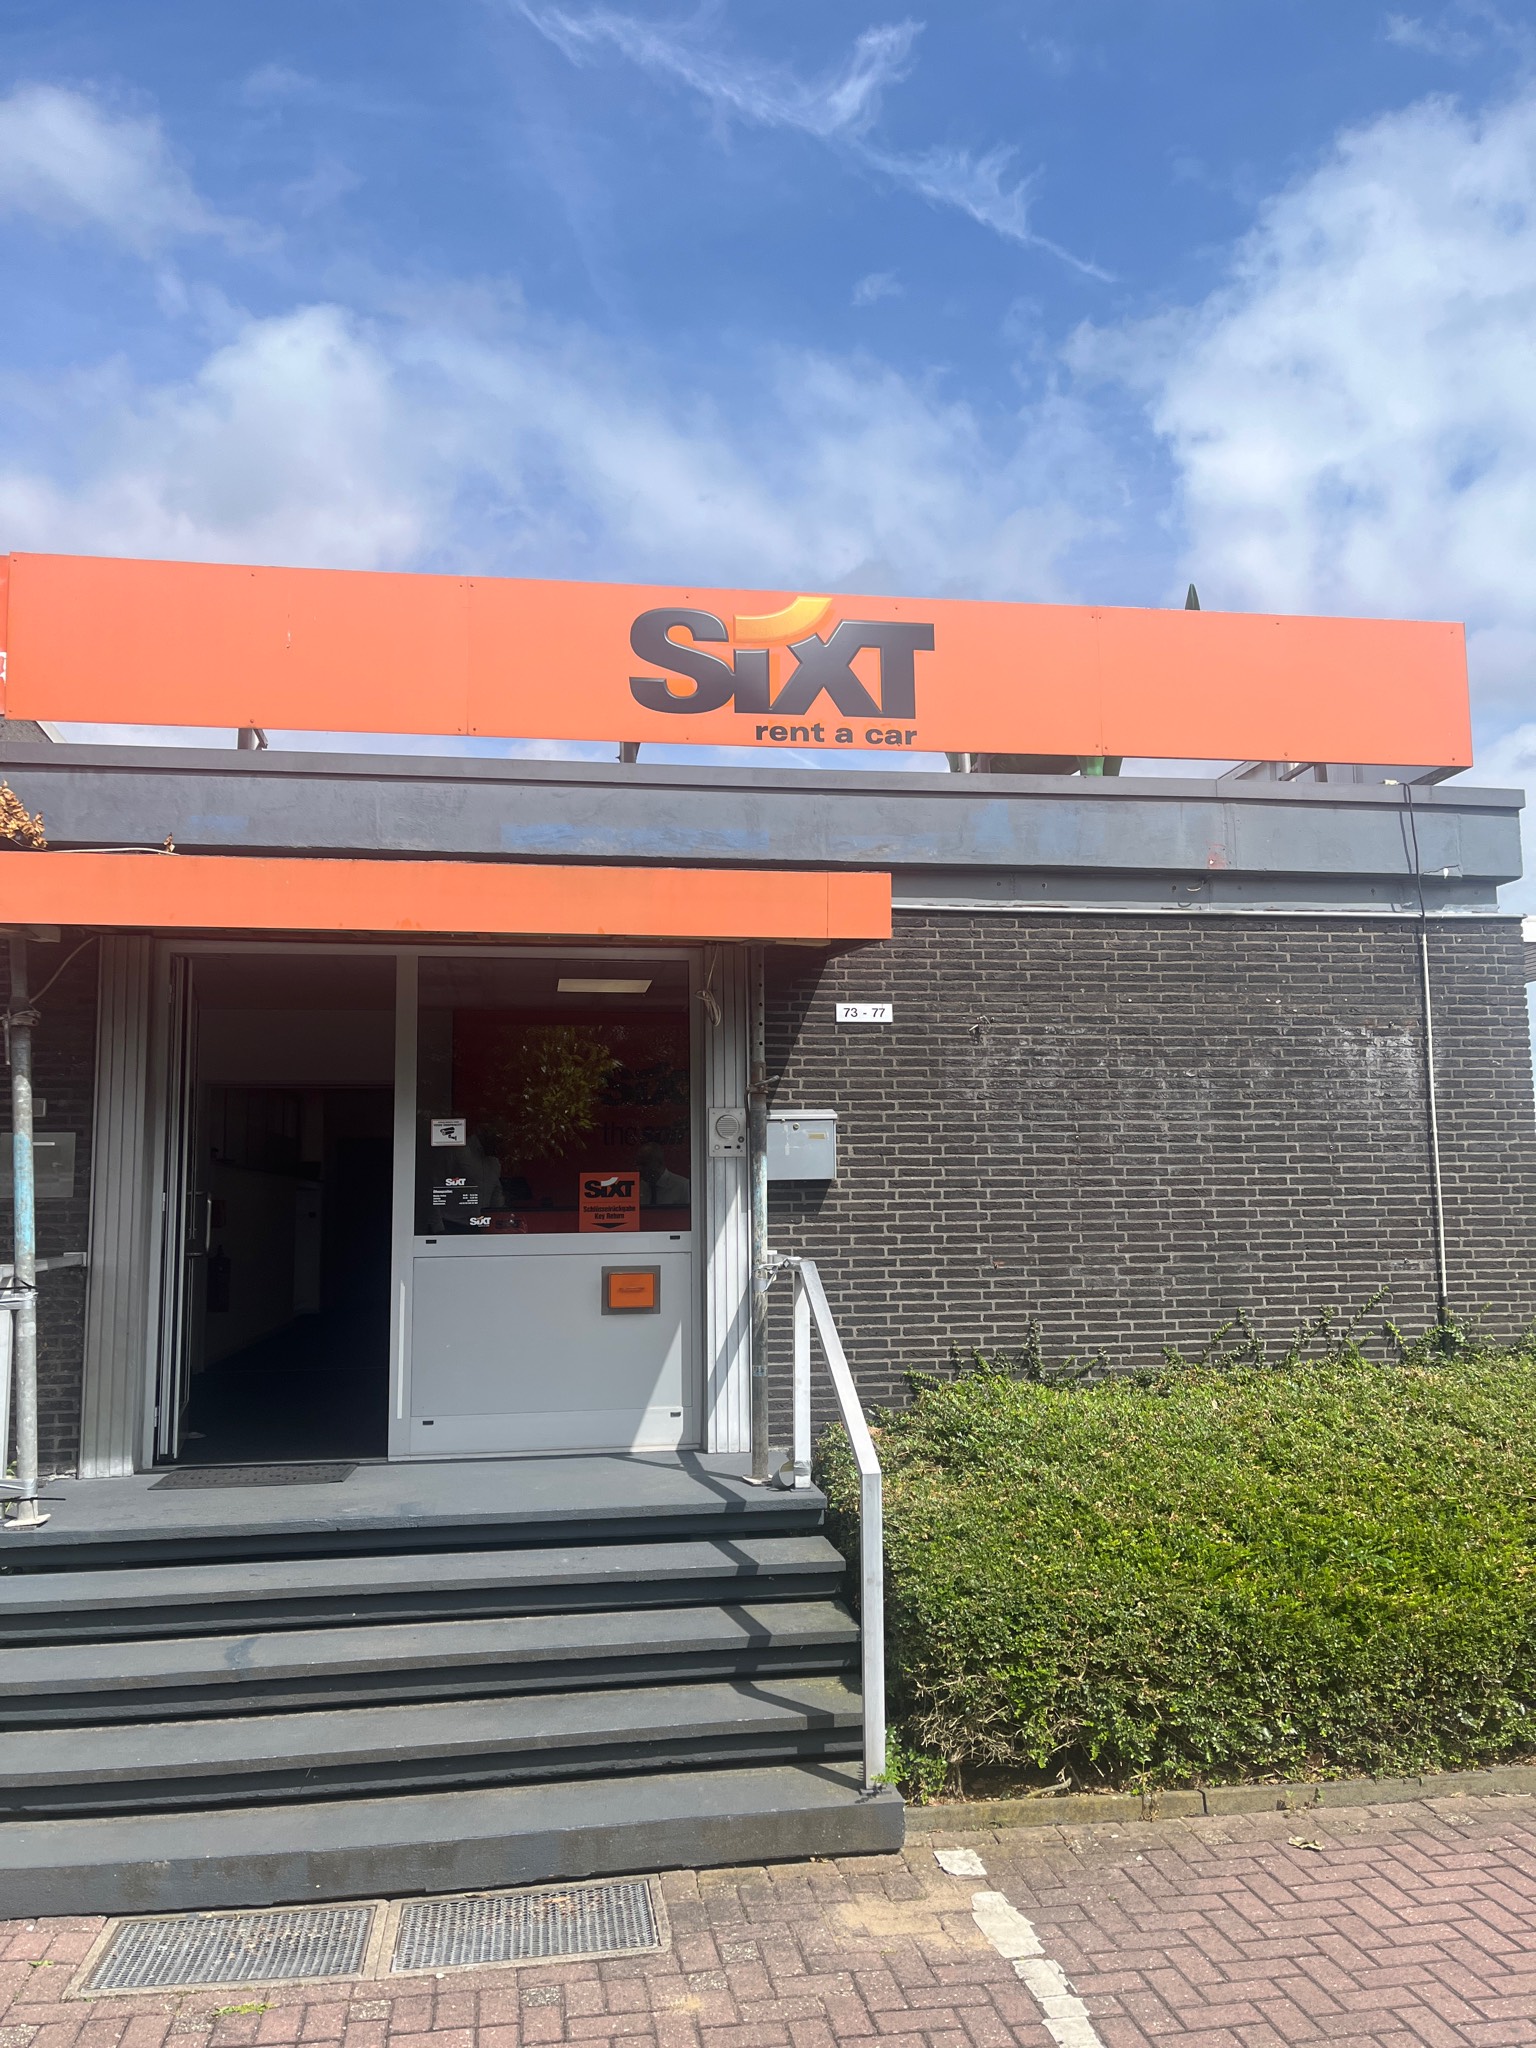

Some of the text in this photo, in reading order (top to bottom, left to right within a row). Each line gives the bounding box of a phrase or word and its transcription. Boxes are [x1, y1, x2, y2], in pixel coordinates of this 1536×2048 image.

[629, 597, 935, 719] SIXT
[755, 723, 918, 746] rent a car
[843, 1007, 858, 1018] 73
[871, 1007, 886, 1018] 77
[584, 1177, 635, 1198] SIXT
